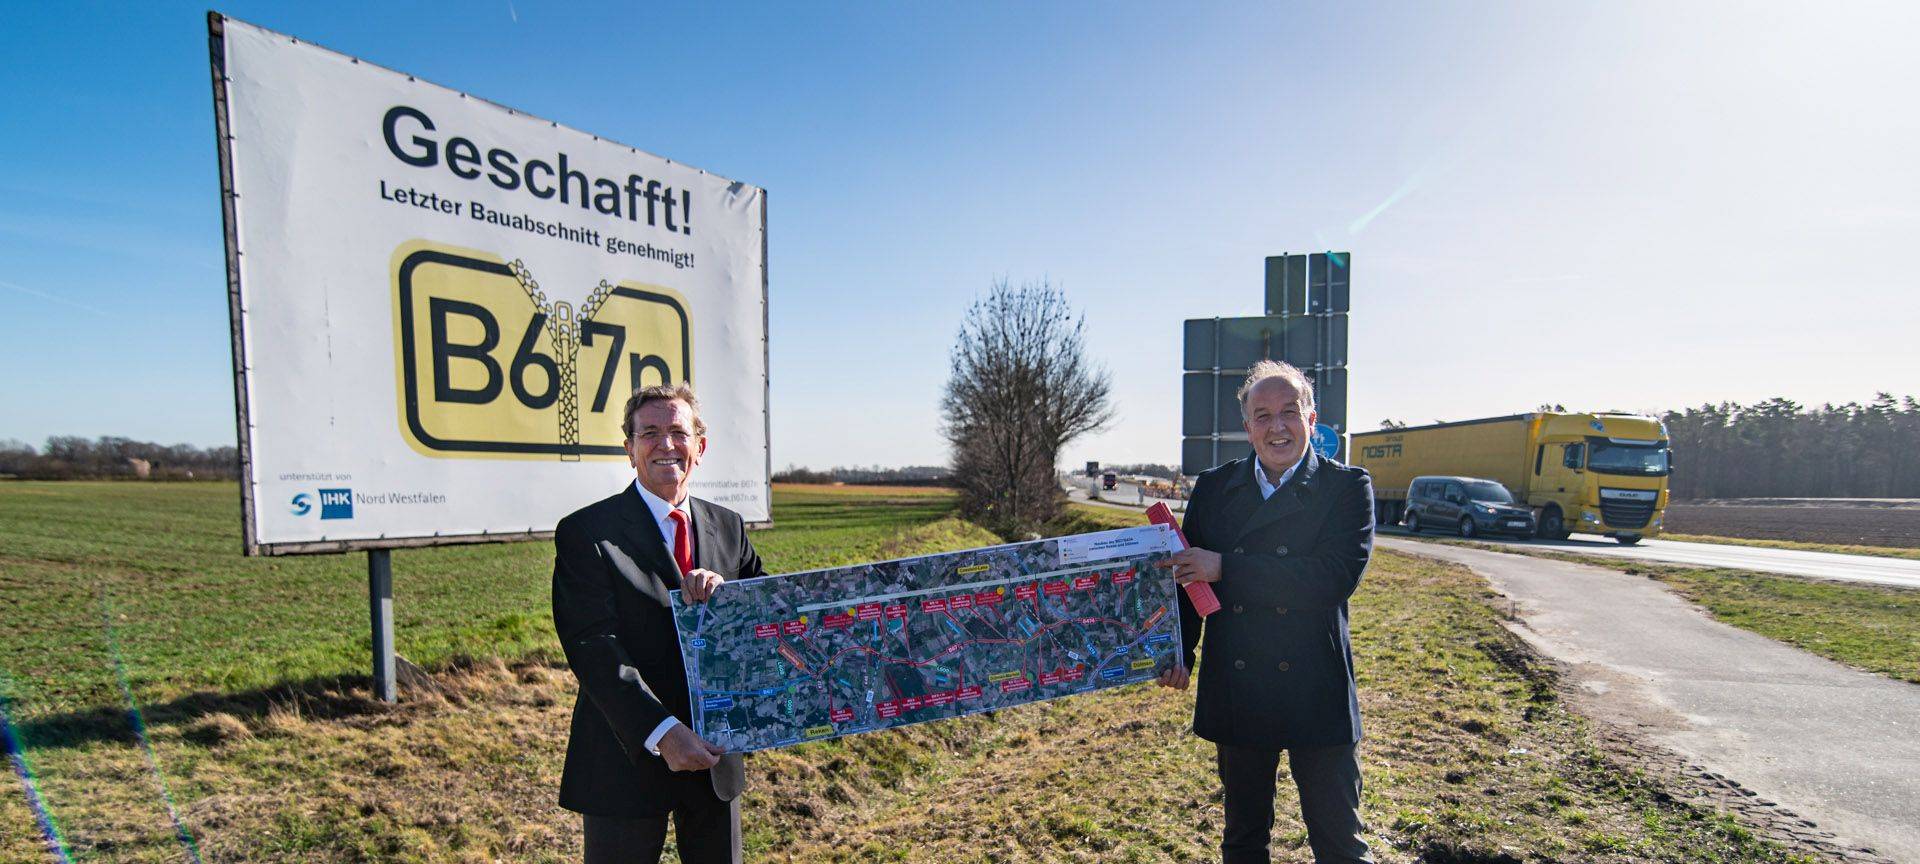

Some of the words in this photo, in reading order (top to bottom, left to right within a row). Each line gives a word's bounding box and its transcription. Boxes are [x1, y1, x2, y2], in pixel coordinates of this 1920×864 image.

[382, 105, 691, 235] Geschafft!
[380, 180, 463, 216] Letzter
[471, 201, 600, 247] Bauabschnitt
[606, 237, 695, 269] genehmigt!
[279, 471, 332, 481] unterstützt
[335, 473, 352, 481] von
[322, 492, 351, 506] IHK
[356, 492, 386, 505] Nord
[389, 492, 447, 505] Westfalen
[809, 726, 830, 736] Reken
